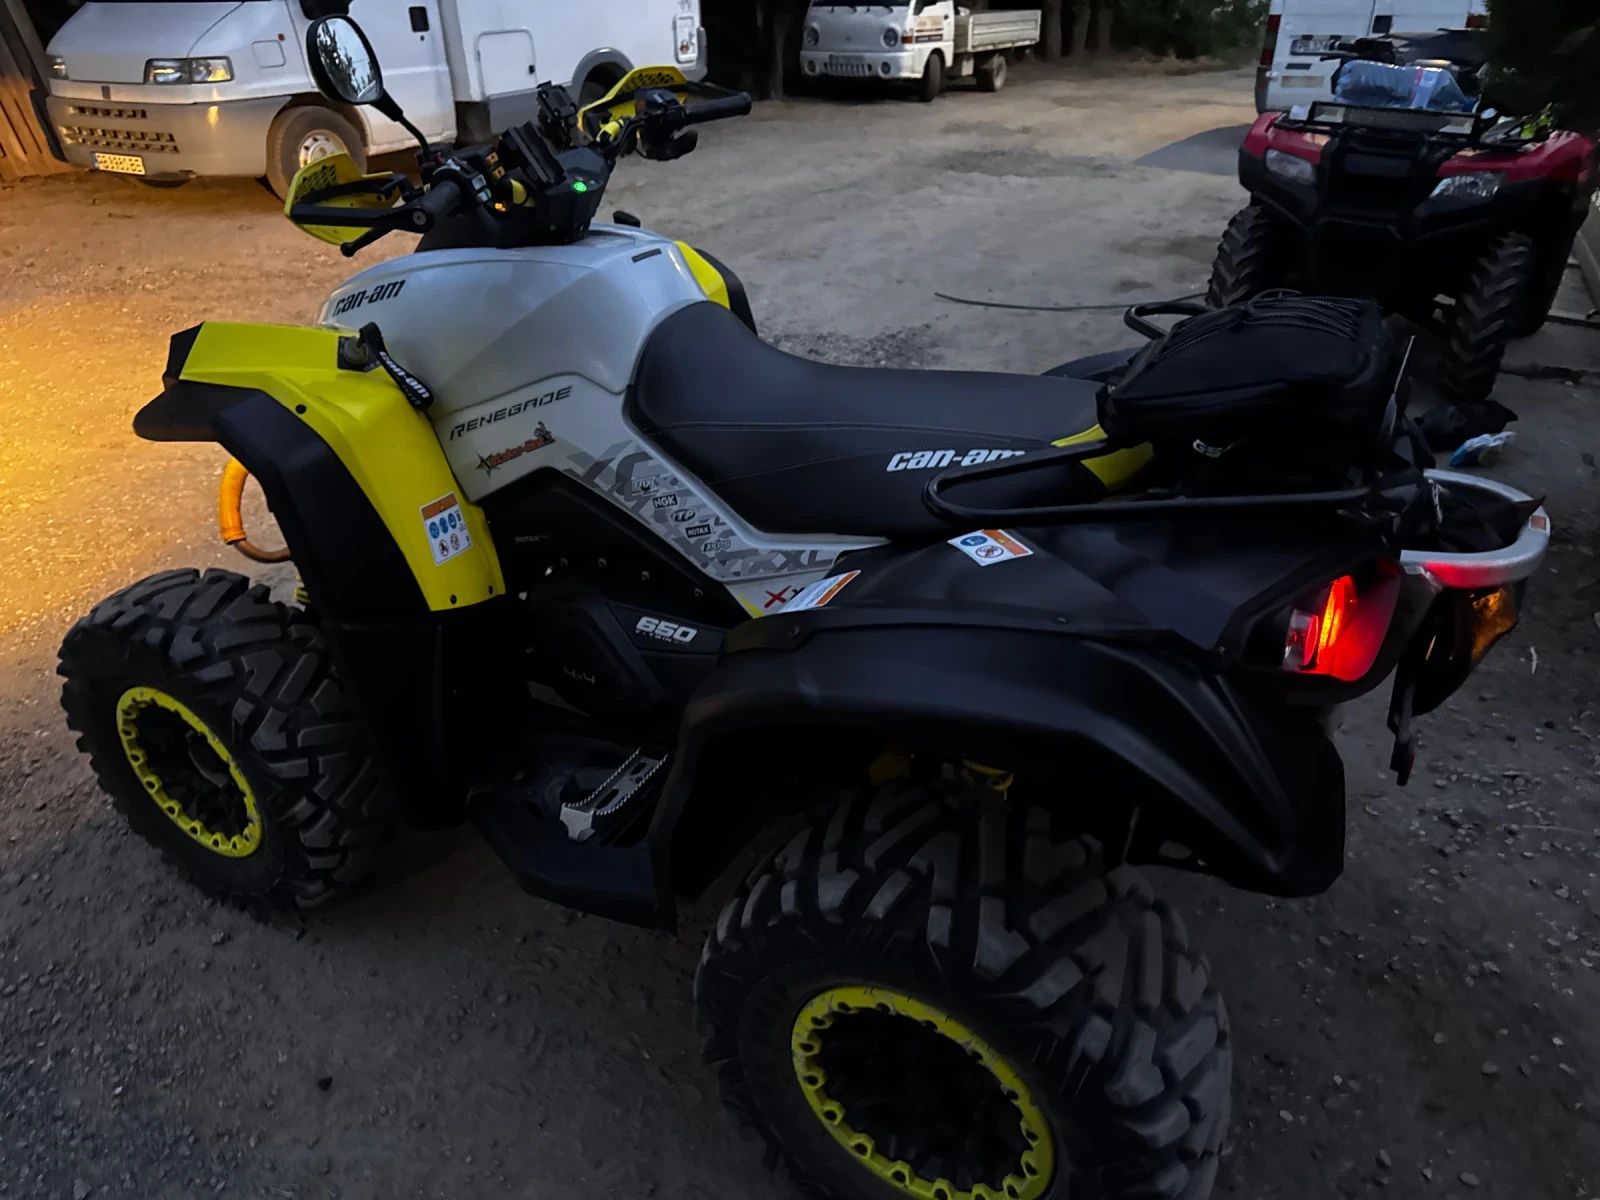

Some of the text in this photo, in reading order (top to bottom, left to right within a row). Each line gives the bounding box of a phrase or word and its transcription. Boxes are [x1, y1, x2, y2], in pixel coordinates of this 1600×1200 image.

[332, 279, 406, 317] can-am
[449, 386, 573, 440] RENEGADE
[653, 496, 676, 508] NGK
[687, 526, 709, 538] ROTAX
[635, 615, 698, 643] 650
